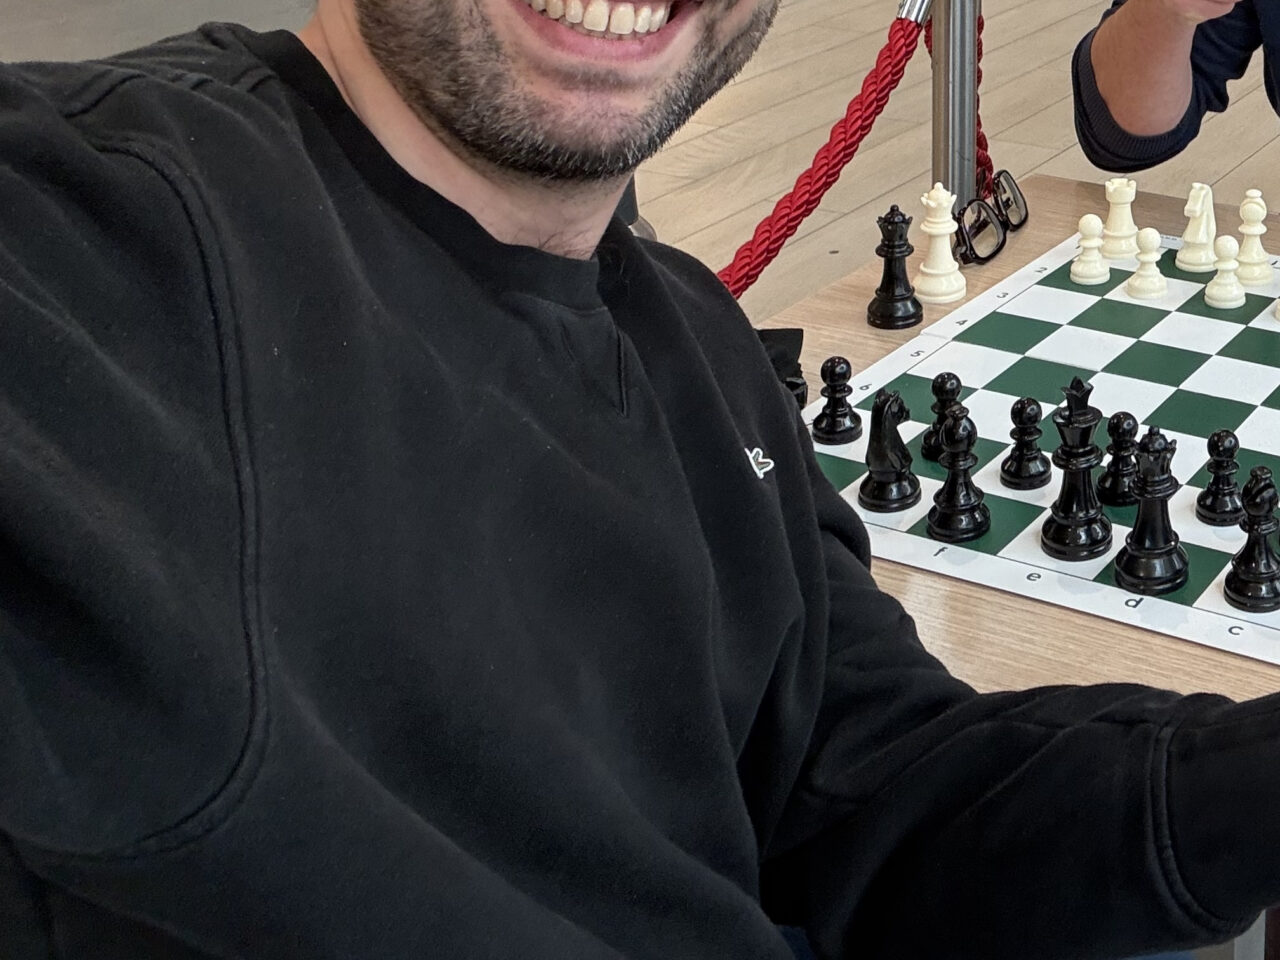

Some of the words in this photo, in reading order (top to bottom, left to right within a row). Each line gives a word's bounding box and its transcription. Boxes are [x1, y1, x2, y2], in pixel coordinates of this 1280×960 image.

[955, 318, 969, 327] 4
[910, 349, 925, 358] 5
[859, 383, 874, 392] 6
[932, 546, 948, 557] f
[1026, 572, 1042, 582] e
[1124, 596, 1145, 609] d
[1227, 625, 1244, 636] c
